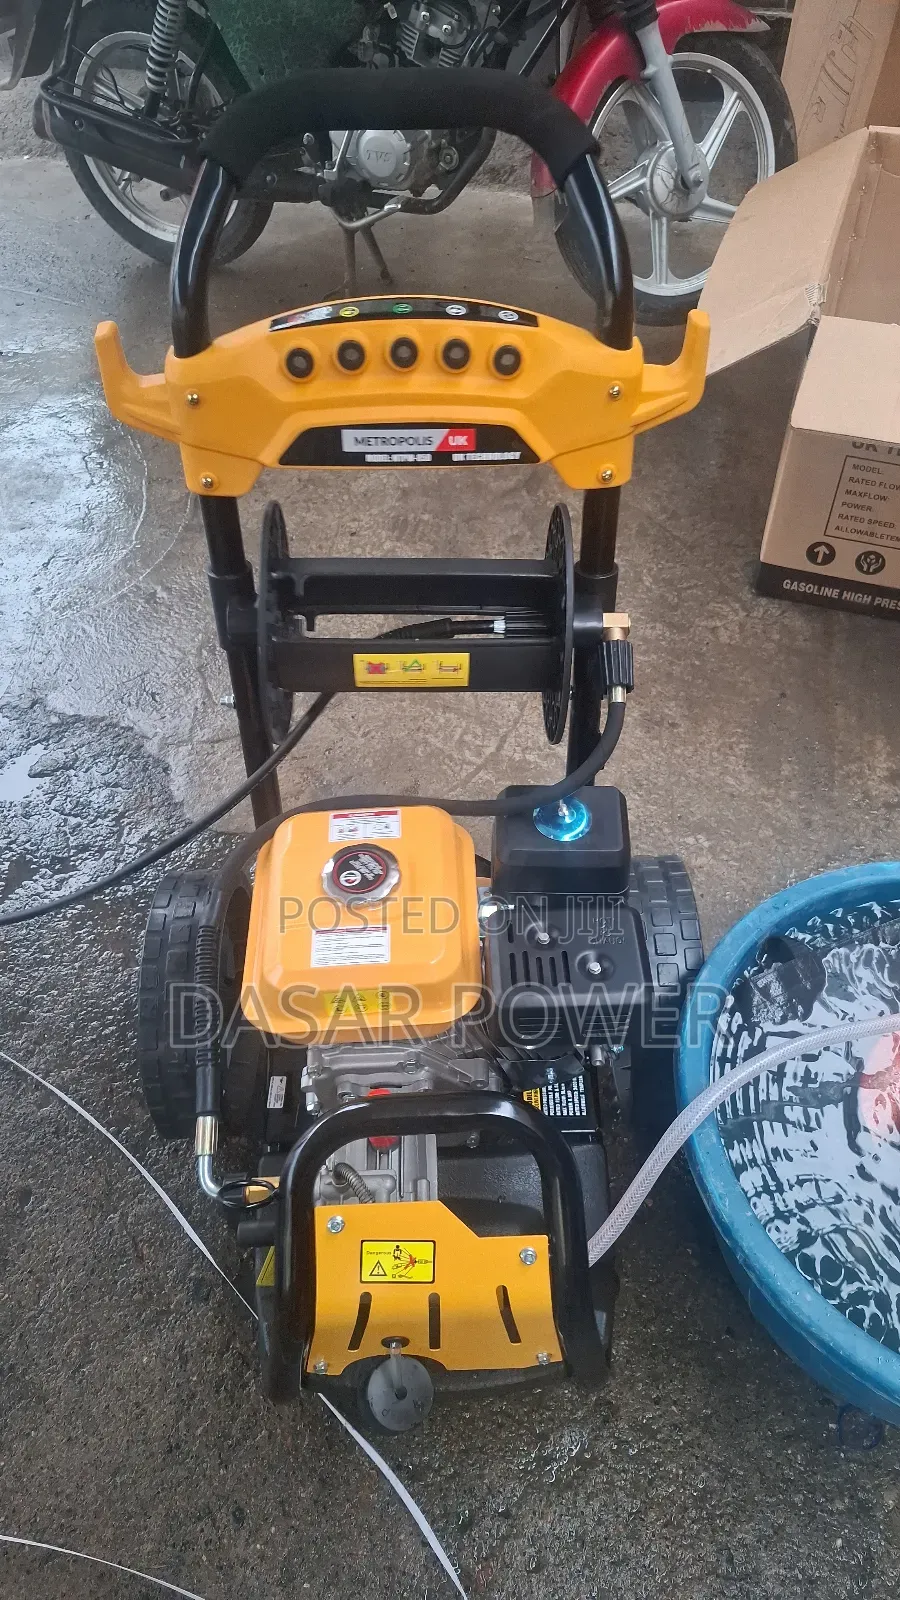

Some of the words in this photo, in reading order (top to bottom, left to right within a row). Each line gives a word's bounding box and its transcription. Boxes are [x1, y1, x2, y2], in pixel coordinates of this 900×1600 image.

[366, 149, 393, 163] TVS
[353, 436, 434, 447] METROPOLIS
[448, 435, 468, 446] UK
[848, 476, 877, 487] RATED
[838, 513, 865, 524] RATED
[782, 579, 840, 599] GASOLINE
[841, 590, 872, 605] HIGH
